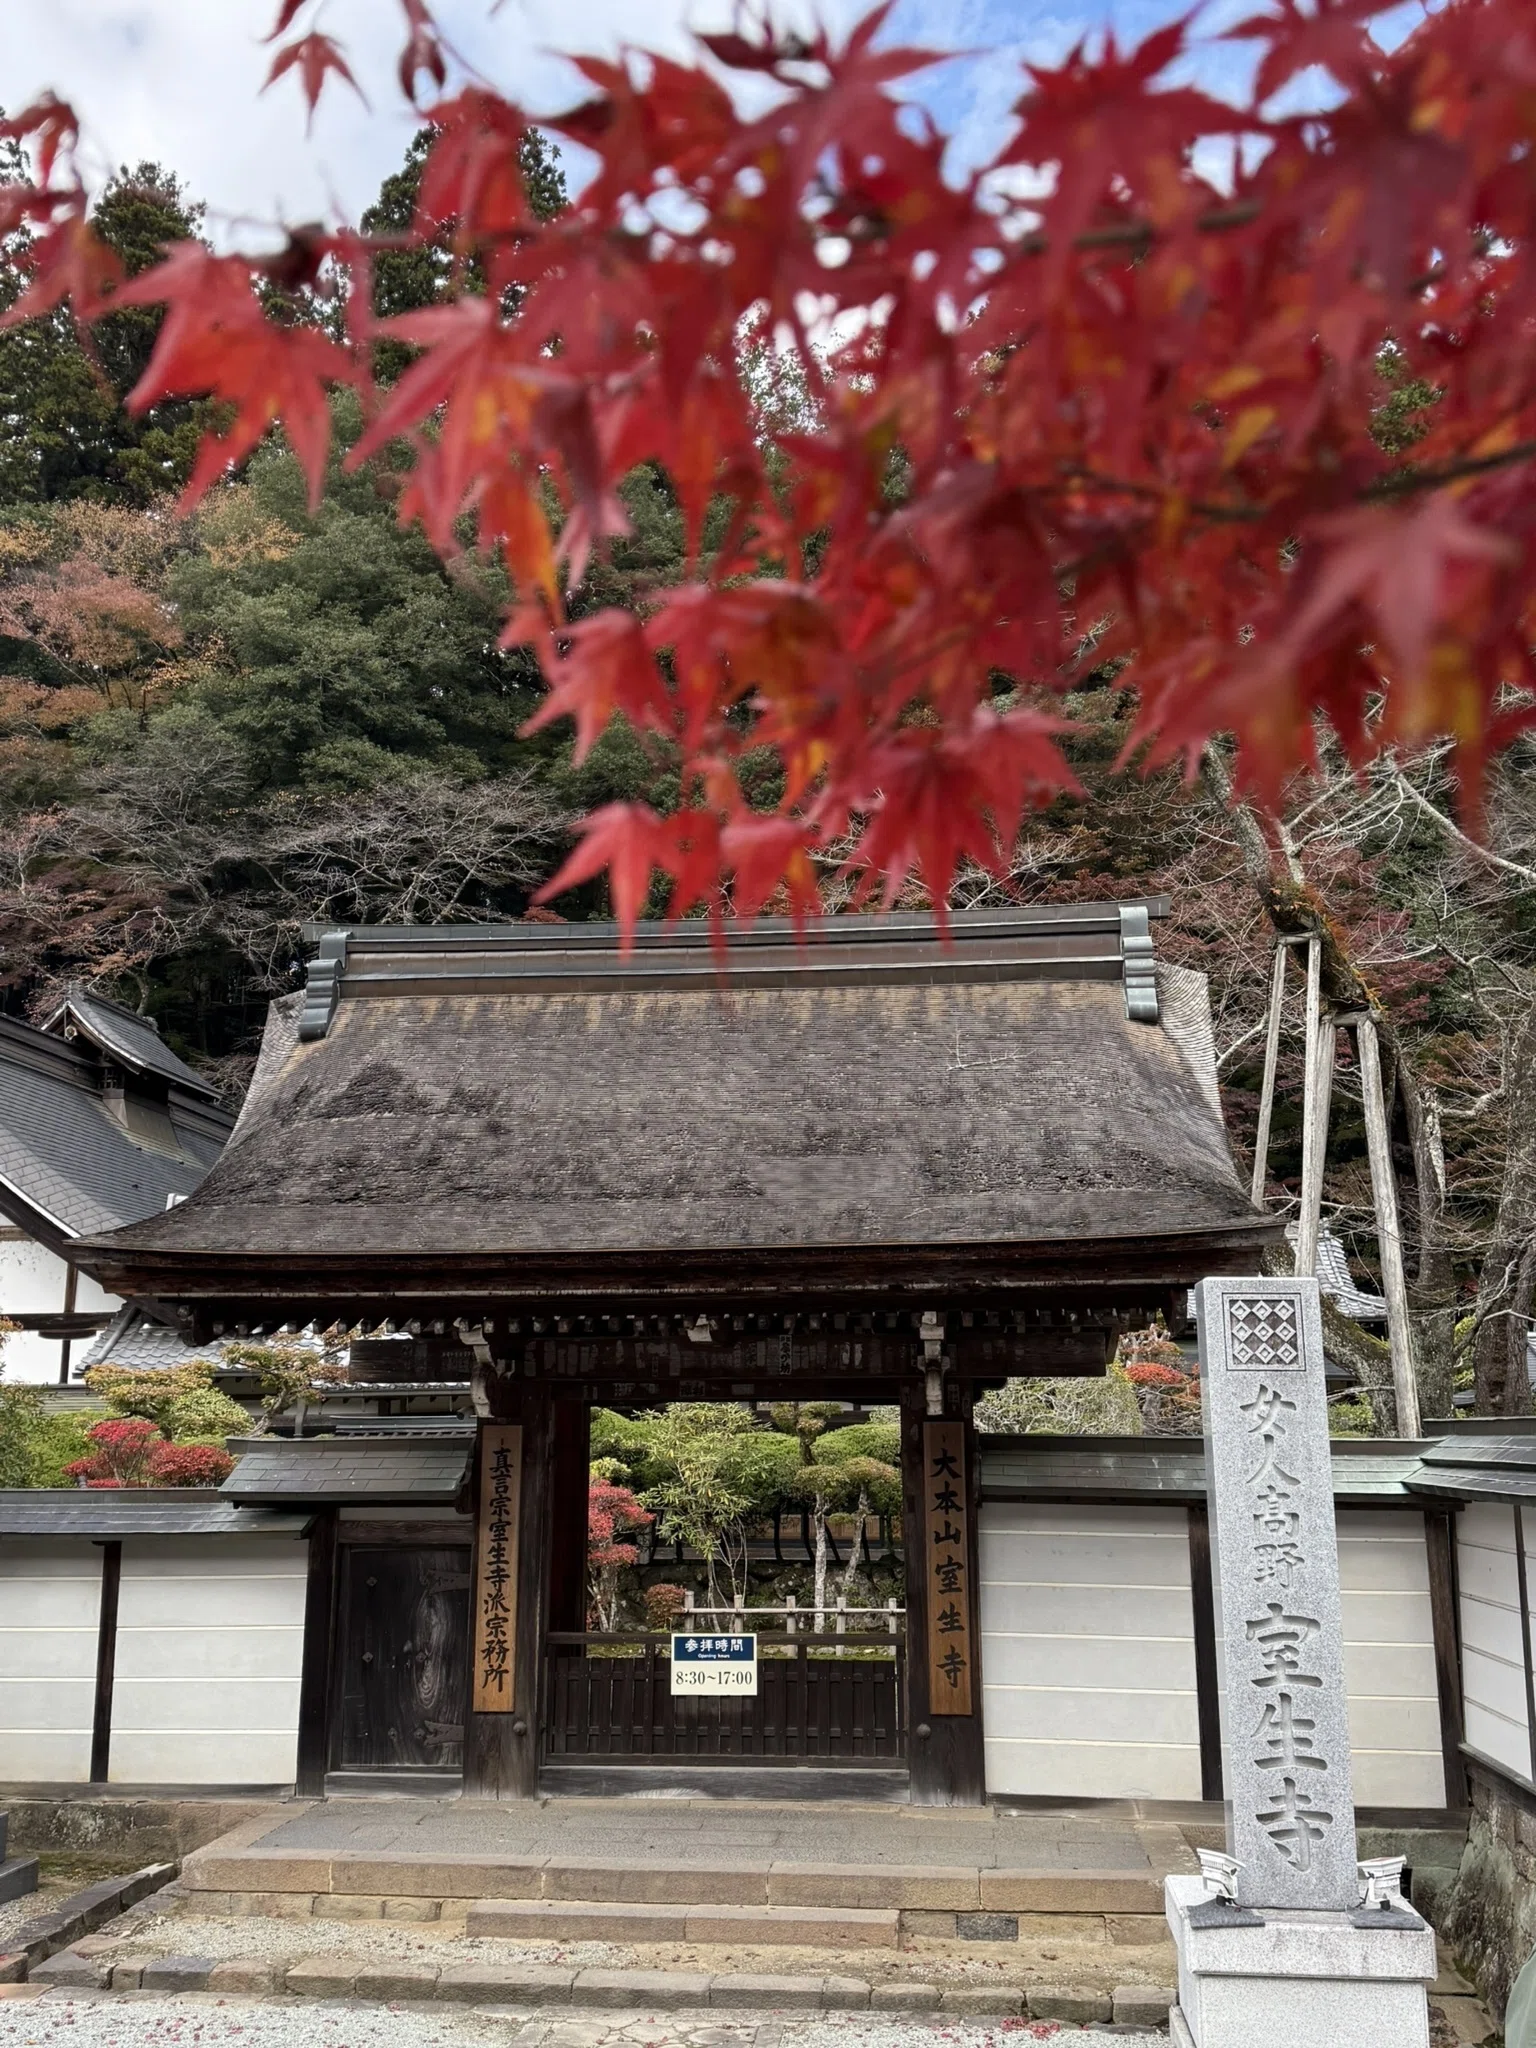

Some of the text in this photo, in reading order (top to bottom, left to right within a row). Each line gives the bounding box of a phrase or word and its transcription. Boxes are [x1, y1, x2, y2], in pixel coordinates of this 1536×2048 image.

[929, 1447, 968, 1689] 大本山室生寺
[684, 1638, 744, 1653] 参拝時間
